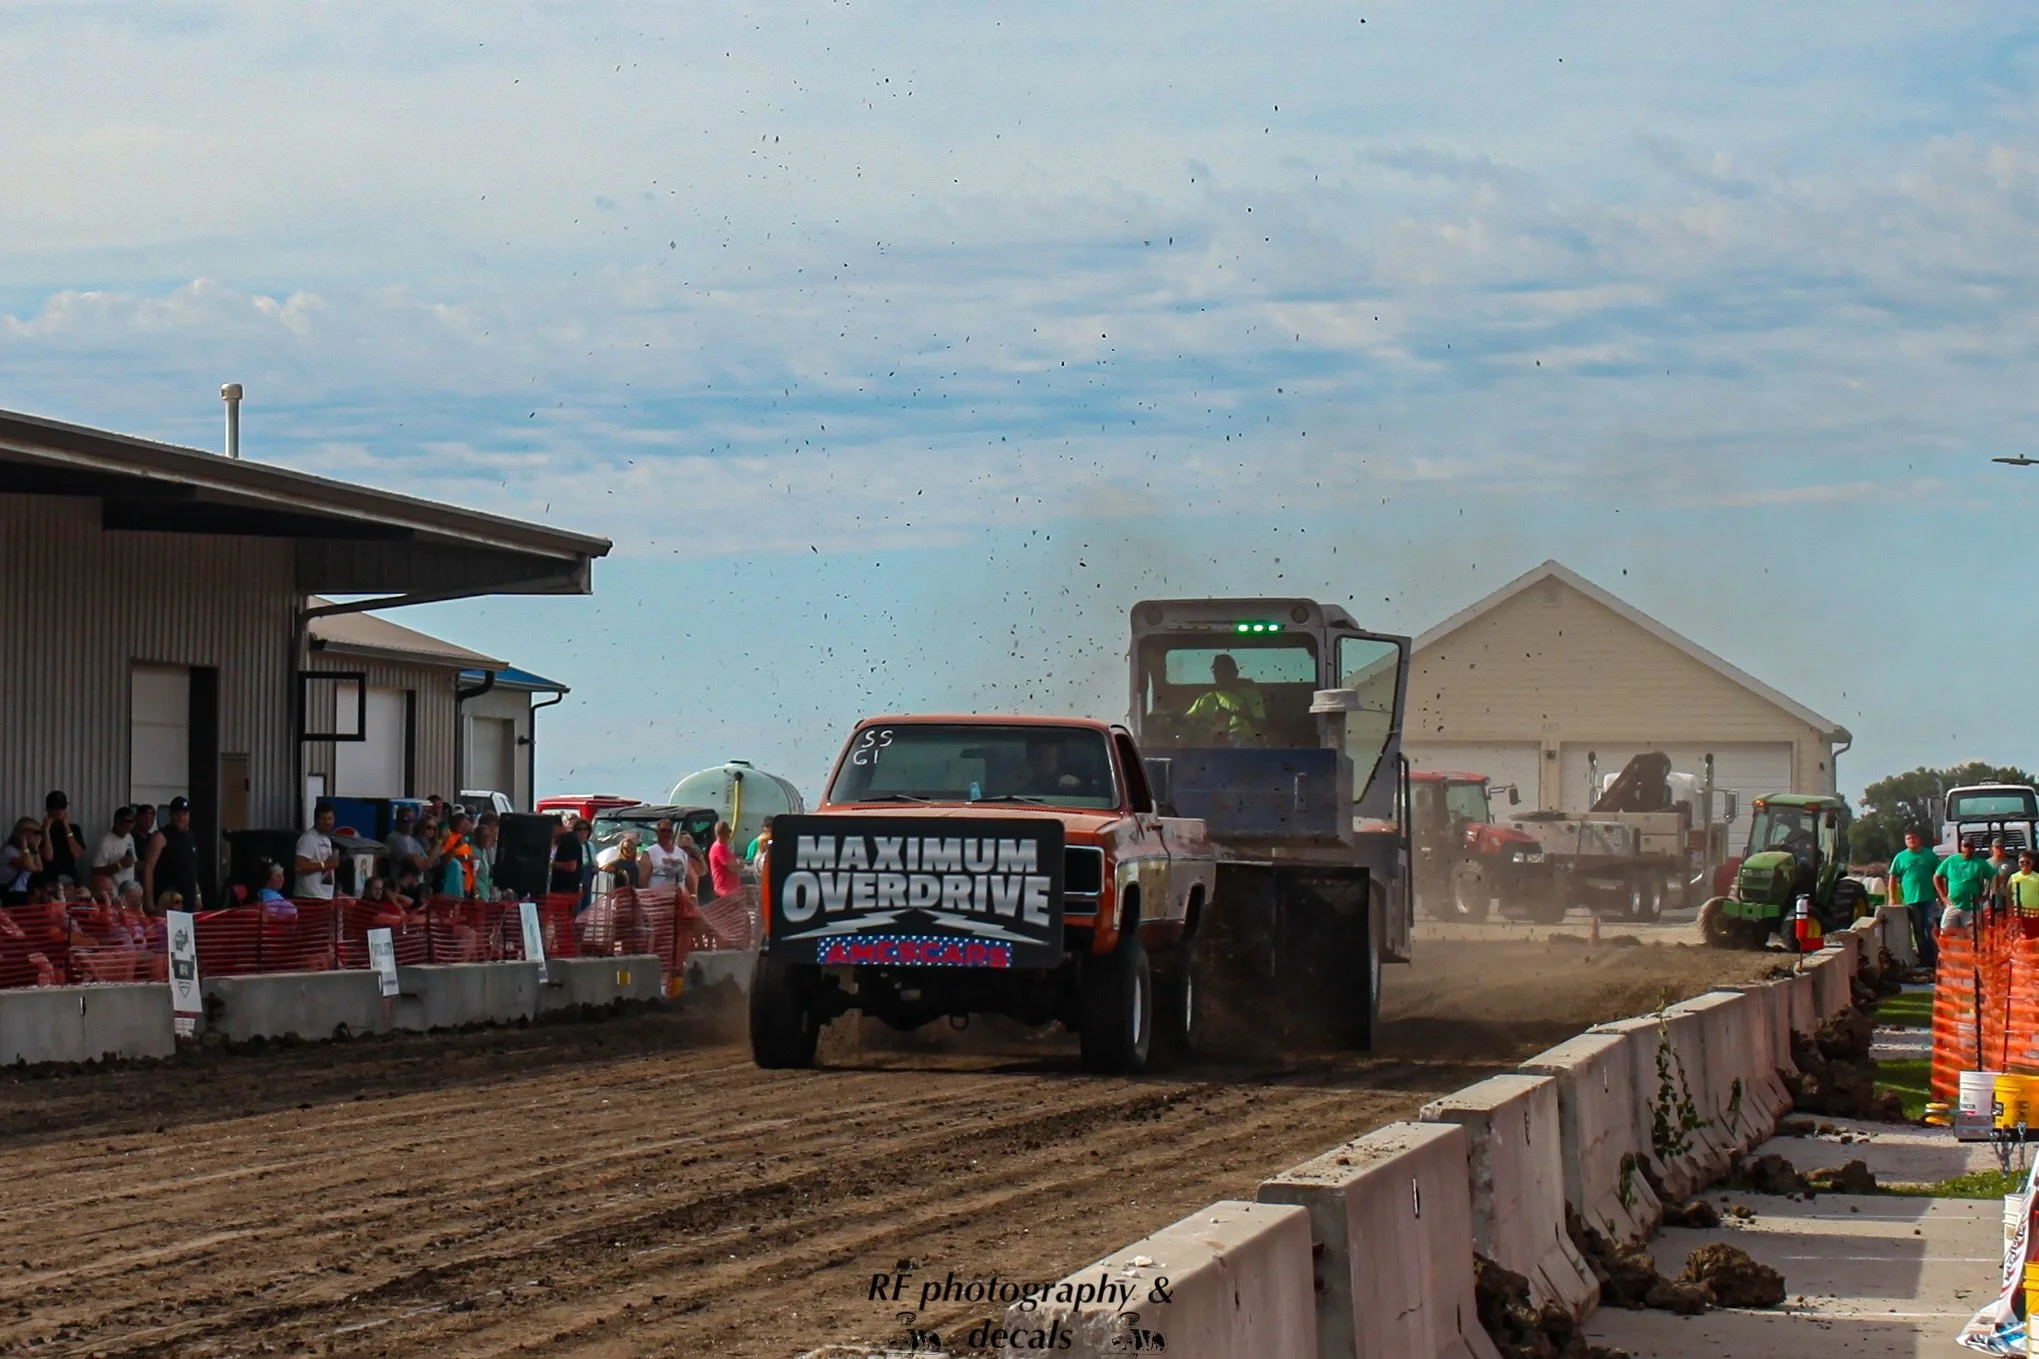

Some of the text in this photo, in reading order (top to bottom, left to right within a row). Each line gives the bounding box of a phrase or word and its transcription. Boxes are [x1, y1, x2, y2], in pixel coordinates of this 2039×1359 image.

[861, 730, 893, 748] SS
[796, 835, 1038, 874] MAXIMUM
[781, 872, 1052, 927] OVERDRIVE
